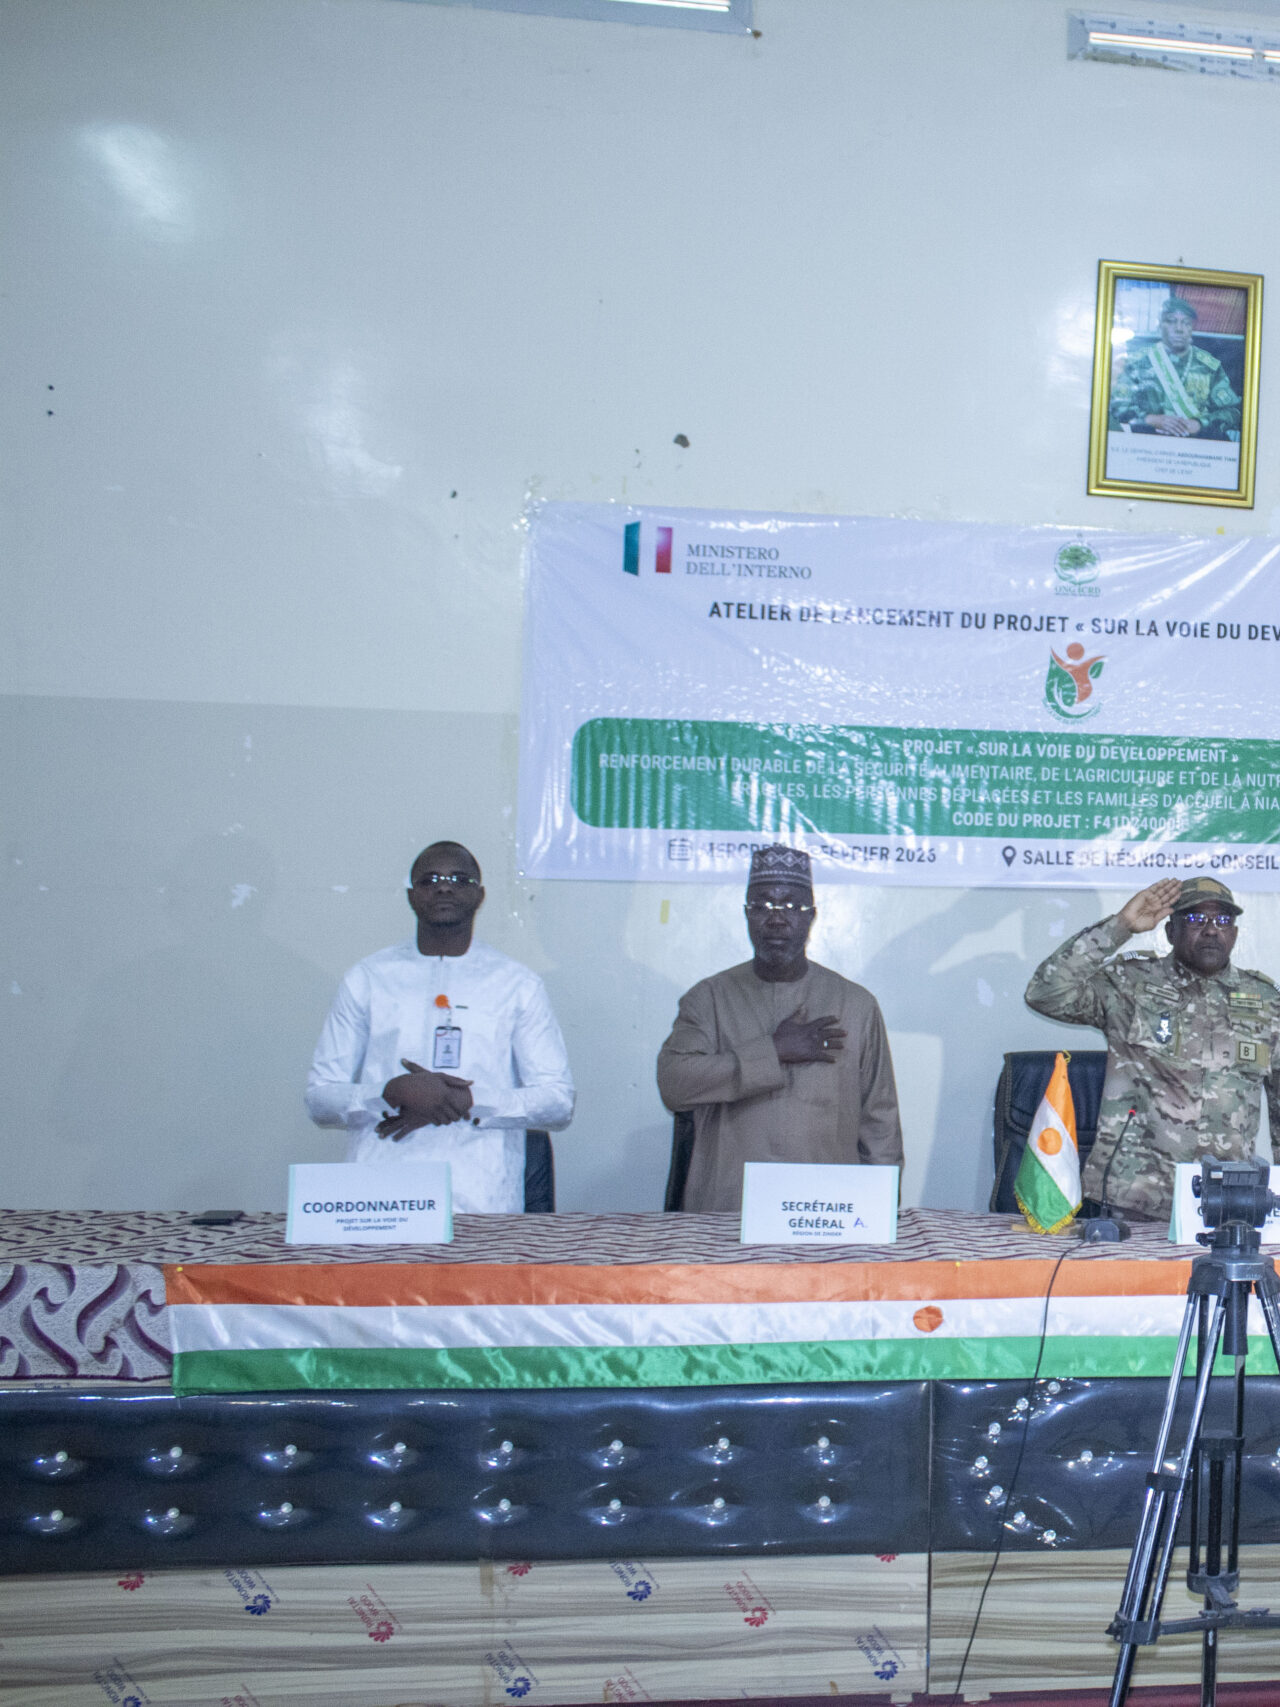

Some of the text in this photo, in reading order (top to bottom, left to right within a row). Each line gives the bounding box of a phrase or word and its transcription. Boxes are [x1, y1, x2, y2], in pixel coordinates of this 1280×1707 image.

[687, 544, 779, 560] MINISTERO
[686, 561, 812, 579] DELL'INTERNO
[708, 601, 792, 622] ATELIER
[799, 606, 824, 623] DE
[831, 606, 955, 628] LANCEMENT
[960, 611, 986, 630] DU
[993, 612, 1070, 633] PROJET
[1091, 617, 1129, 635] SUR
[1135, 619, 1160, 637] LA
[1165, 620, 1211, 639] VOIE
[1216, 622, 1241, 640] DU
[903, 739, 964, 755] PROJET
[978, 741, 1008, 757] SUR
[1012, 742, 1034, 758] LA
[1036, 743, 1072, 759] VOIE
[1076, 744, 1096, 760] DU
[1100, 745, 1228, 763] DEVELOPPEMENT
[599, 753, 725, 771] RENFORCEMENT
[731, 757, 801, 774] DURABLE
[806, 760, 825, 775] DE
[829, 761, 849, 775] LA
[1041, 767, 1060, 782] DE
[1064, 767, 1174, 785] L'AGRICULTURE
[1179, 770, 1196, 785] ET
[1201, 771, 1219, 786] DE
[1223, 772, 1242, 786] LA
[813, 783, 841, 799] LES
[1033, 789, 1052, 805] ET
[1056, 791, 1083, 806] LES
[1087, 791, 1159, 808] FAMILLES
[952, 811, 994, 827] CODE
[998, 812, 1018, 827] DU
[1022, 813, 1082, 829] PROJET
[1023, 849, 1075, 866] SALLE
[1210, 854, 1279, 871] CONSEIL
[302, 1199, 436, 1214] COORDONNATEUR
[781, 1200, 854, 1213] SECRÉTAIRE
[788, 1216, 845, 1229] GÉNÉRAL
